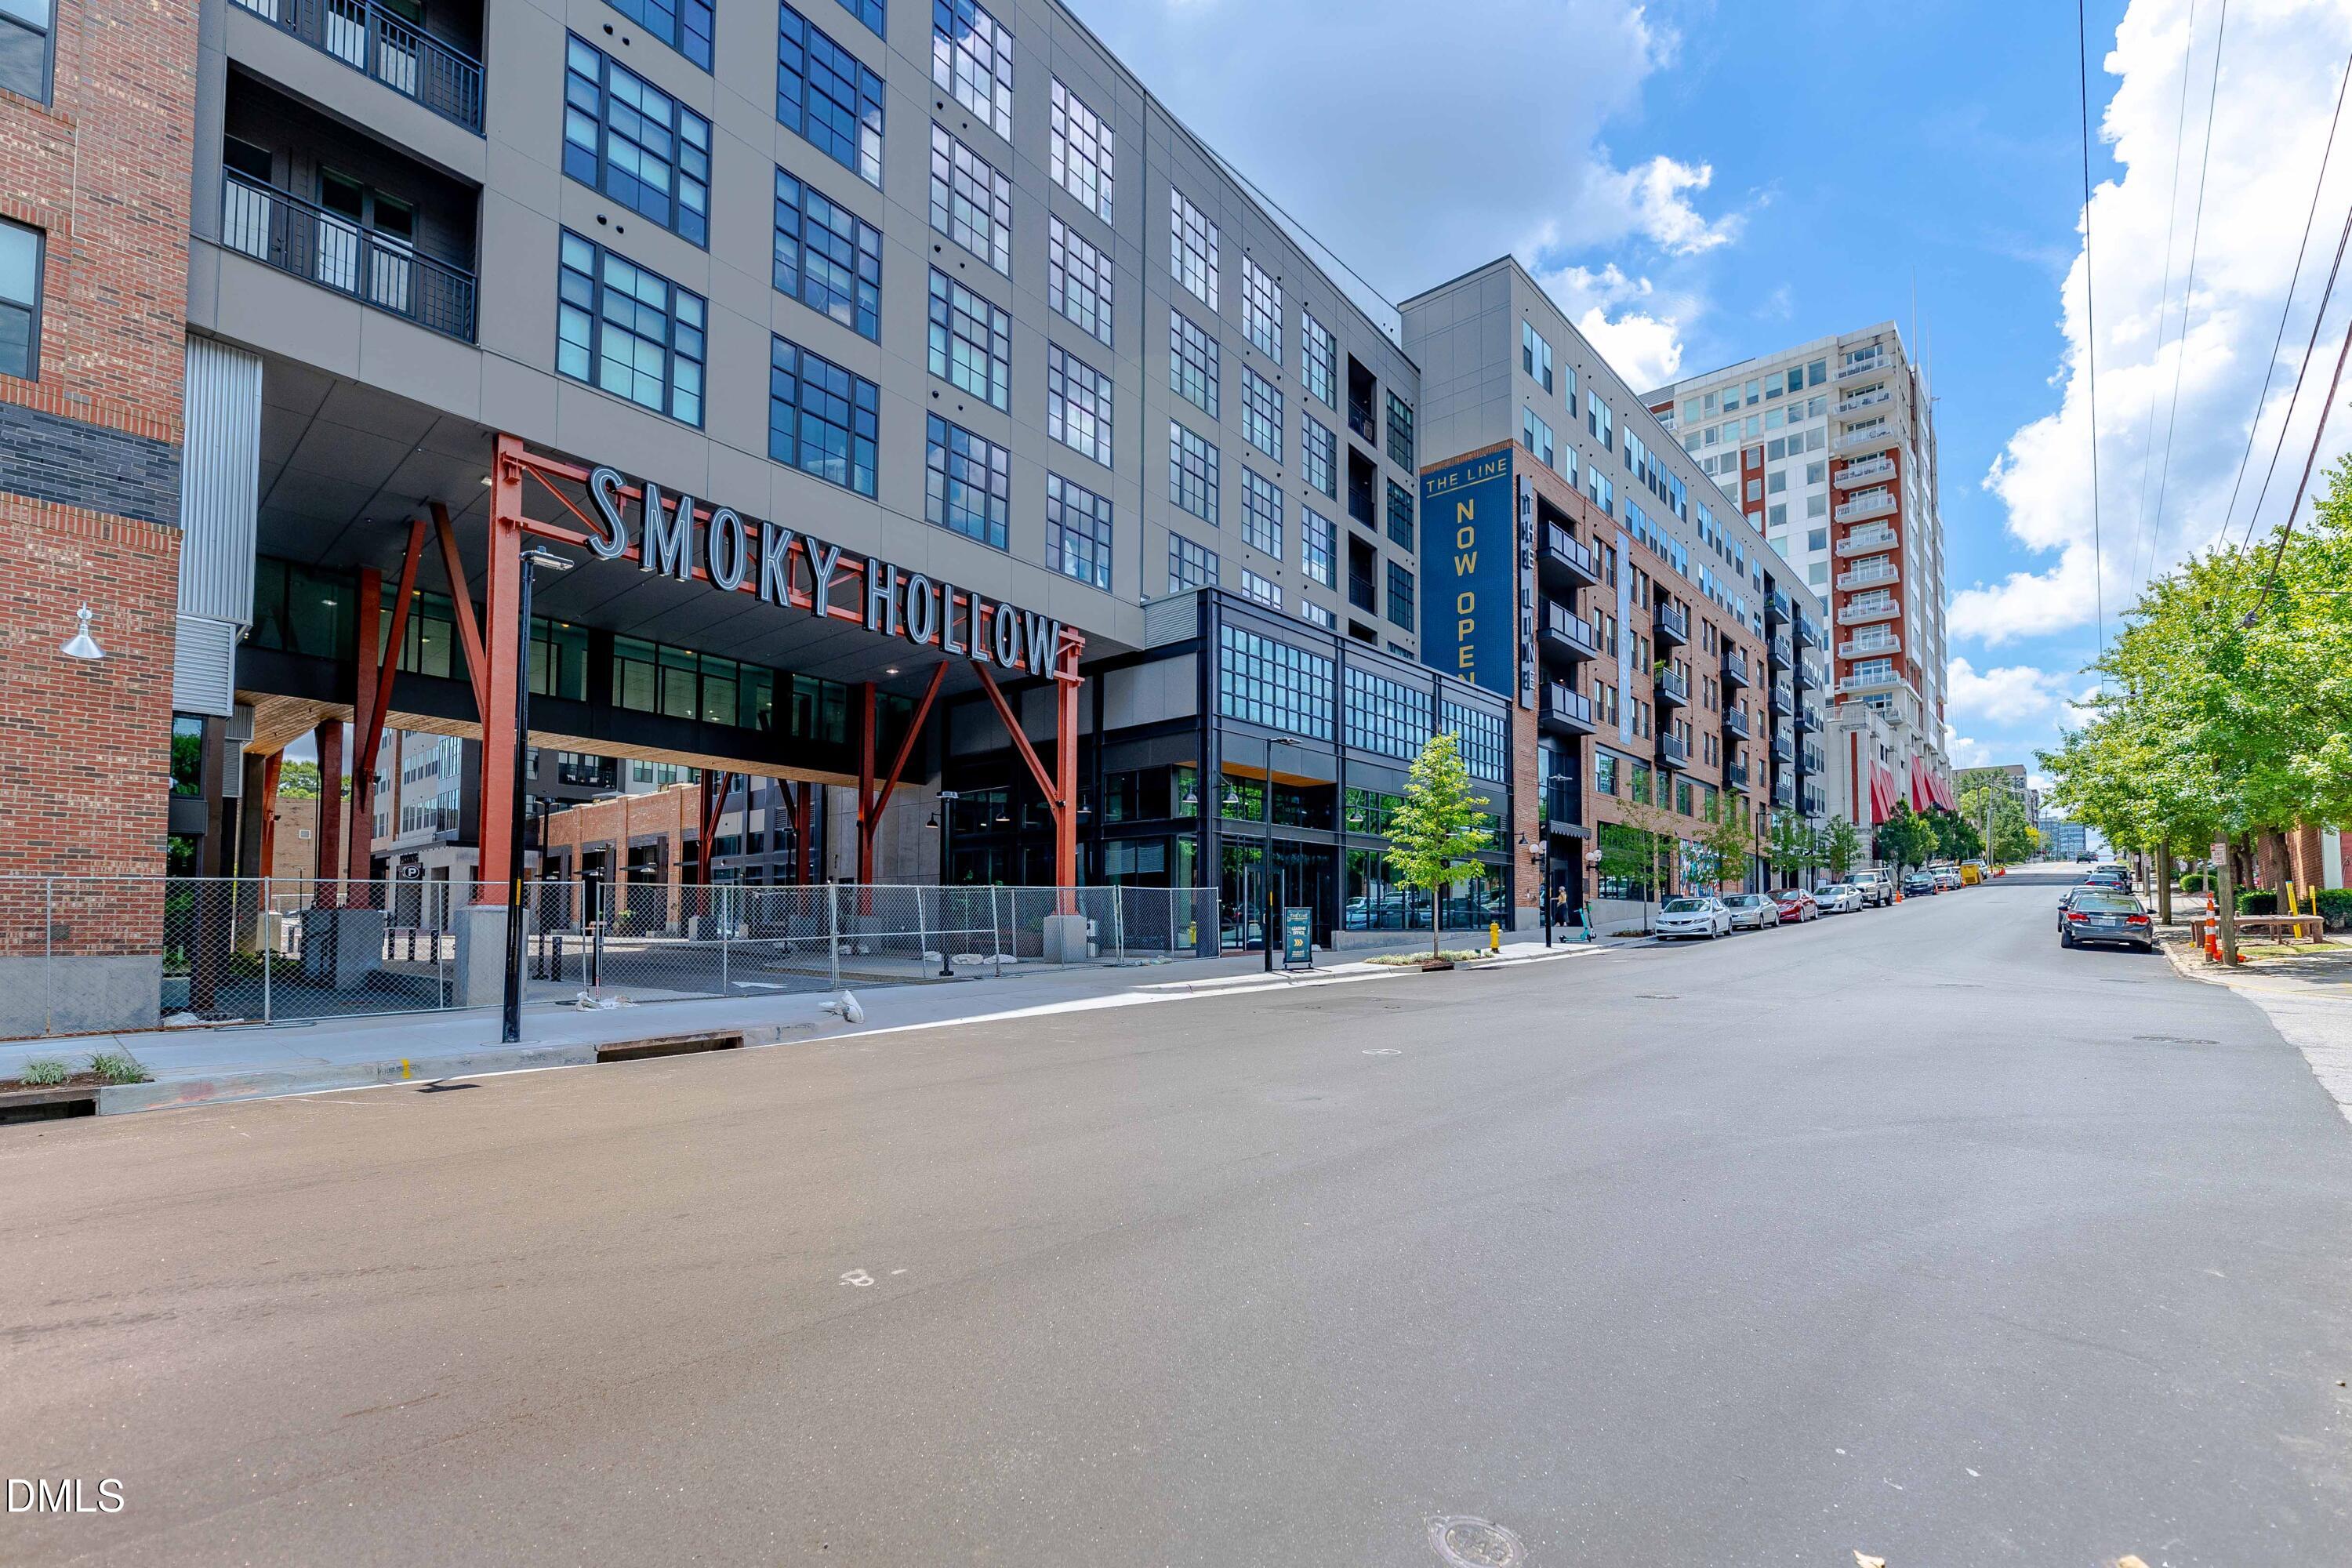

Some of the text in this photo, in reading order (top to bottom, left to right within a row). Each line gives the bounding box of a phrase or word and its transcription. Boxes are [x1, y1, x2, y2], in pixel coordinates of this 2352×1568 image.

[1426, 458, 1507, 492] THE LINE
[1454, 498, 1477, 577] NOW
[1619, 543, 1628, 596] NOW
[585, 464, 1061, 680] SMOKY HOLLOW
[1523, 493, 1536, 691] THE LINE
[408, 868, 416, 877] P
